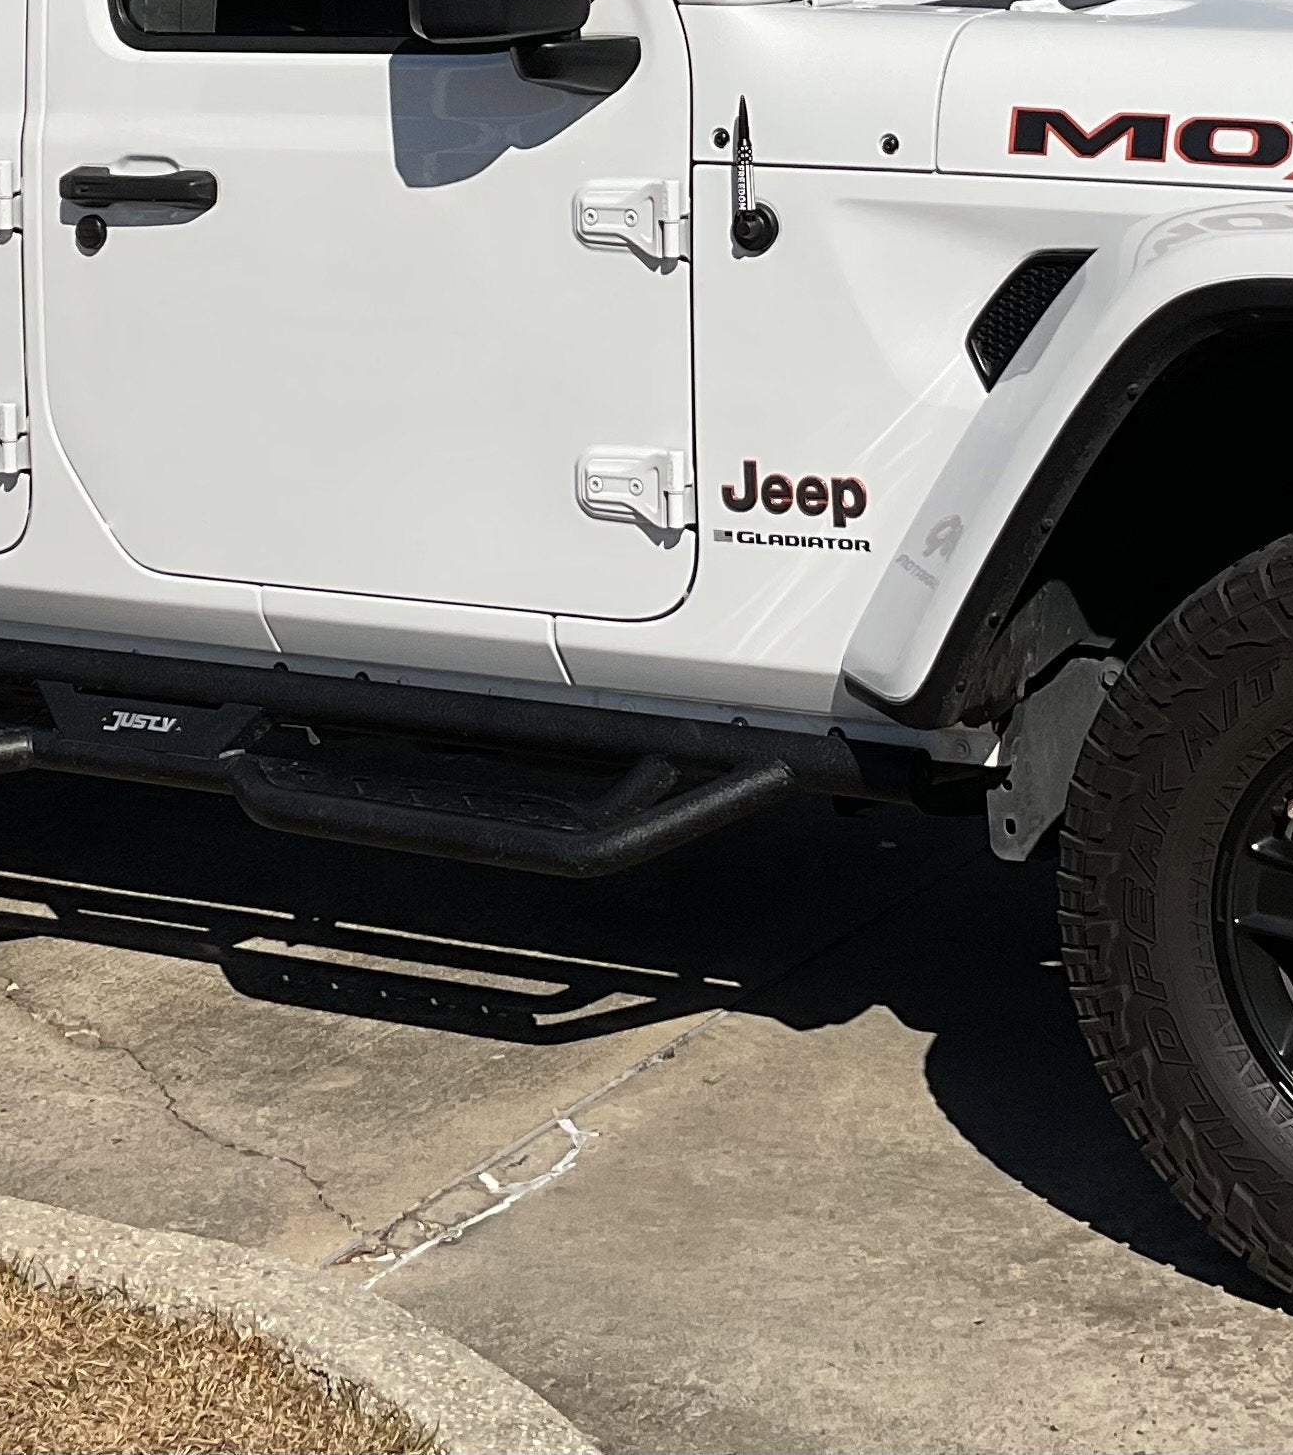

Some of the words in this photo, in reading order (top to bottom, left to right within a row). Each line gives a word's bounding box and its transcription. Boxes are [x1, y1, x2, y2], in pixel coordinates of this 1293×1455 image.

[737, 164, 747, 211] FREEDOM
[721, 459, 868, 528] Jeep
[736, 530, 872, 553] GLADIATOR
